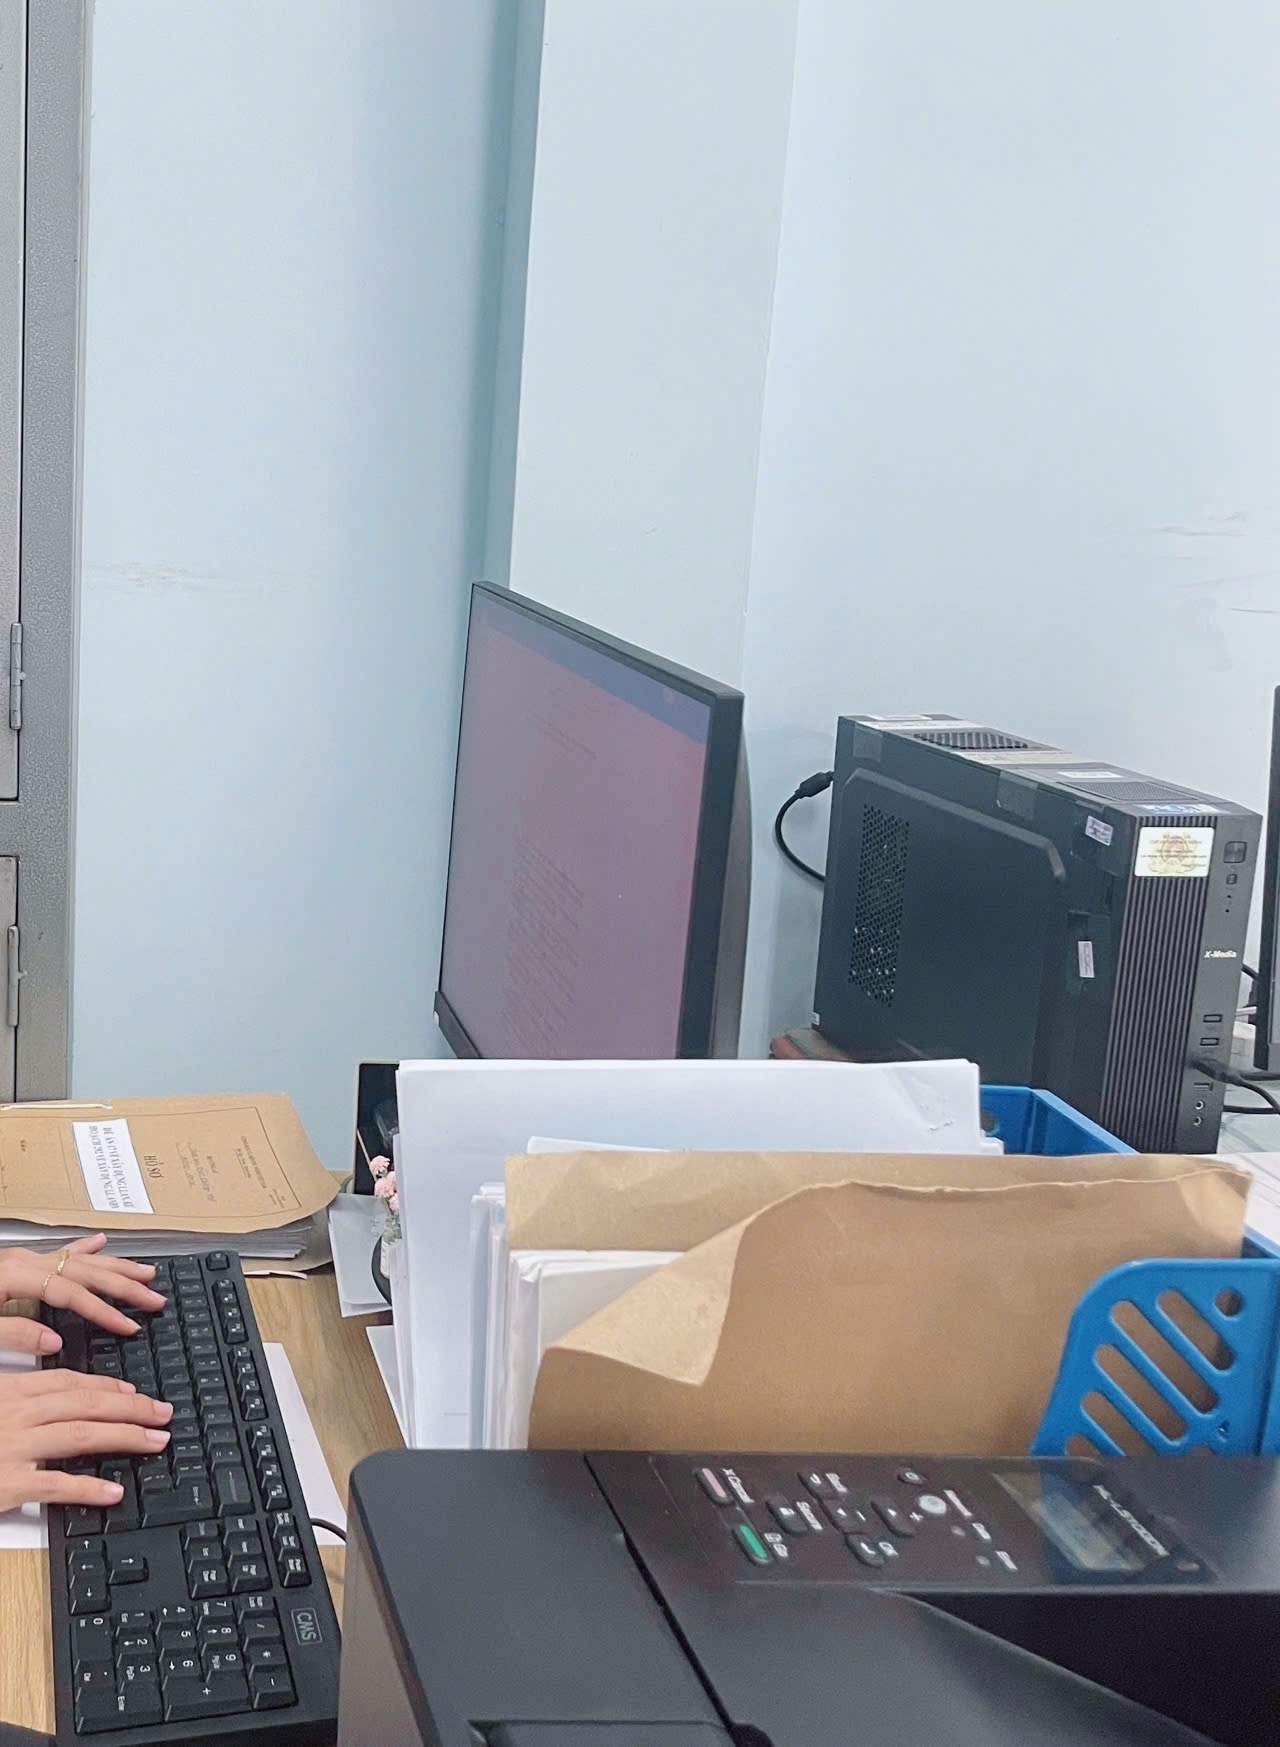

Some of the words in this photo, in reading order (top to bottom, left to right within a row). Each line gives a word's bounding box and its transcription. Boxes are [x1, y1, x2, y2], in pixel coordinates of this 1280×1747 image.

[1203, 950, 1237, 959] X-Media
[296, 1612, 317, 1641] CMS
[181, 1630, 191, 1638] 5
[137, 1638, 148, 1646] 2
[226, 1654, 236, 1662] 9
[182, 1660, 194, 1668] 6
